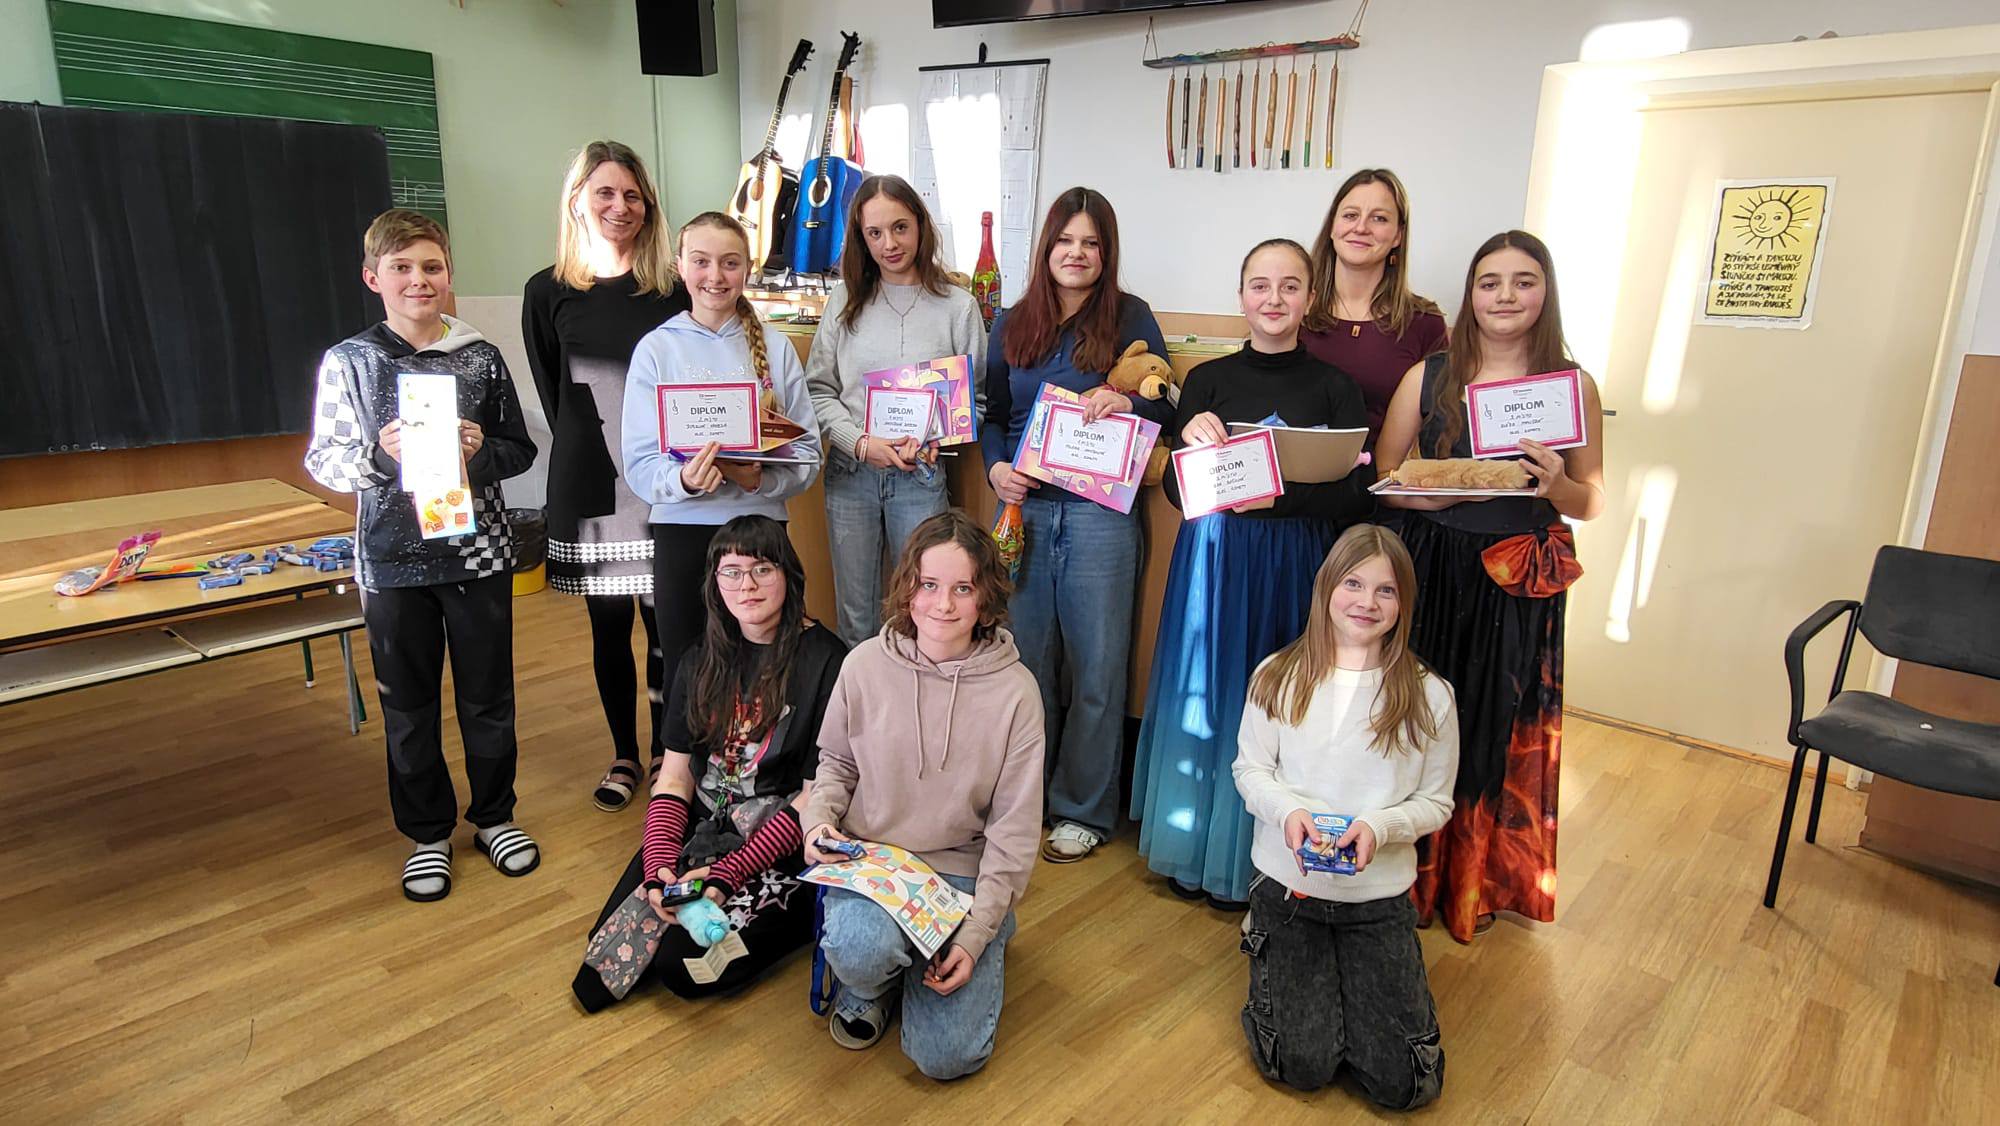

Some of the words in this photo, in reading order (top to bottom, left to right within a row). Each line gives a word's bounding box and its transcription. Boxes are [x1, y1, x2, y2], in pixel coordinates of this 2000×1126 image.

[690, 406, 727, 415] DIPLOM
[887, 407, 914, 415] DIPLOM
[1504, 399, 1545, 413] DIPLOM
[1073, 429, 1105, 442] DIPLOM
[1209, 460, 1245, 475] DIPLOM
